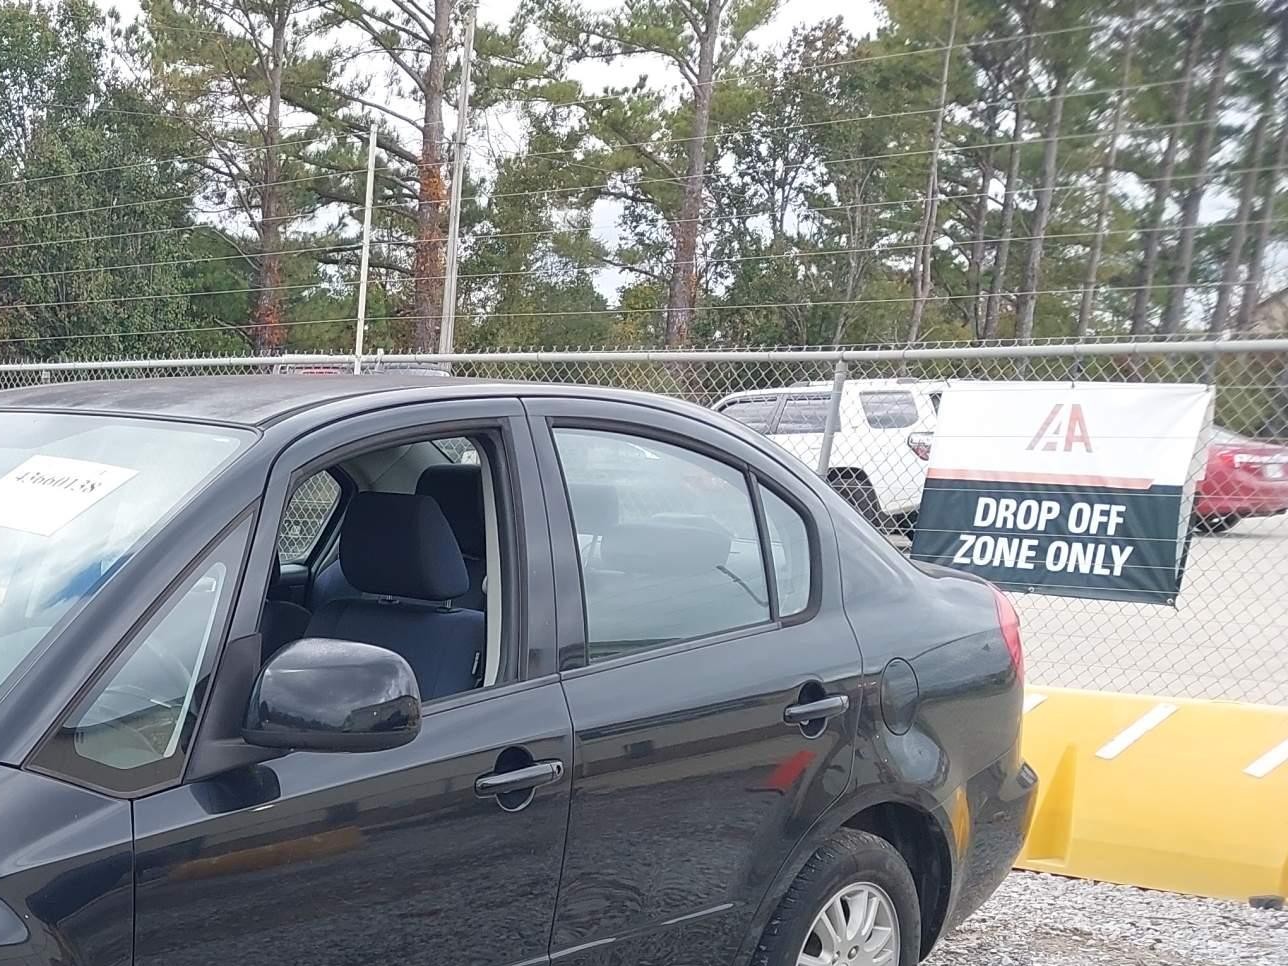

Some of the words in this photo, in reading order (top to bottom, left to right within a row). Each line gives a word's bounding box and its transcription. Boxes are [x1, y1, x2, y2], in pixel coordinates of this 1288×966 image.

[973, 496, 1061, 531] DROP
[1067, 502, 1127, 536] OFF
[952, 534, 1040, 570] ZONE
[1045, 540, 1134, 577] ONLY
